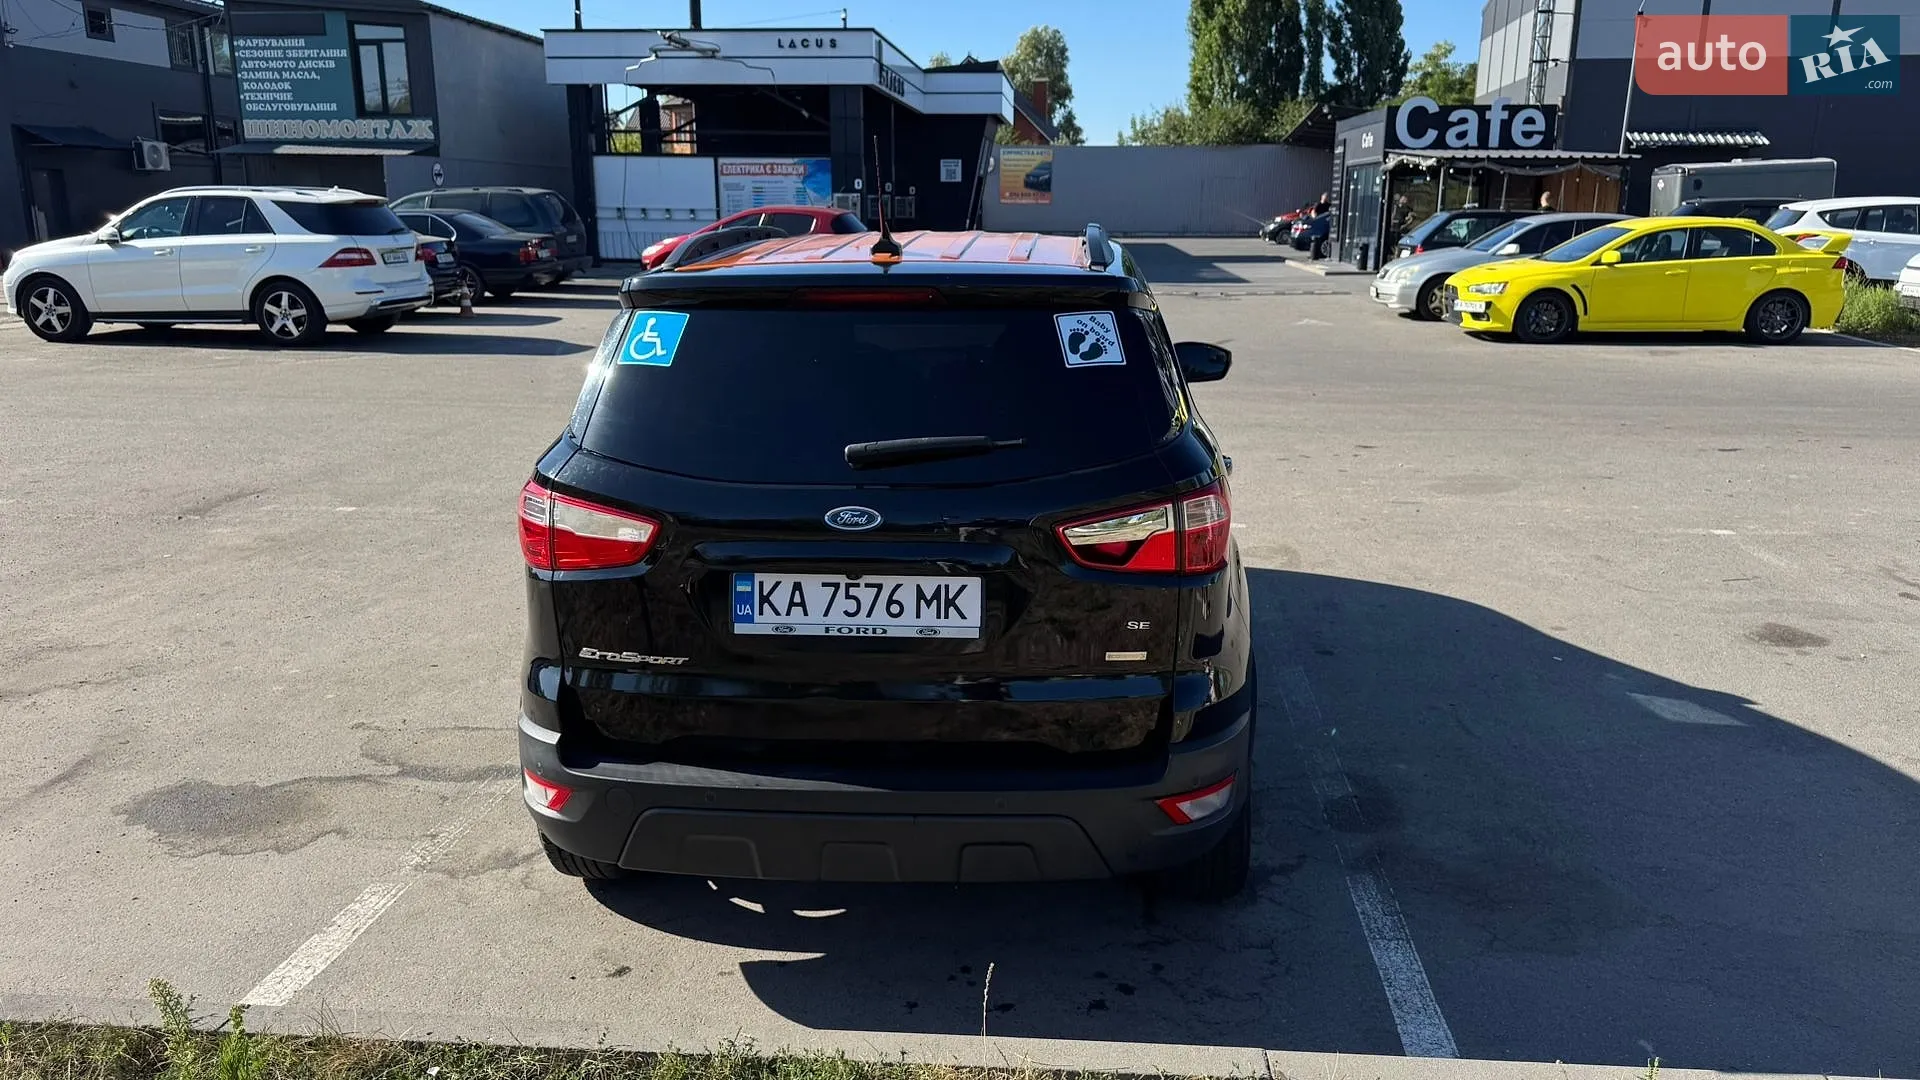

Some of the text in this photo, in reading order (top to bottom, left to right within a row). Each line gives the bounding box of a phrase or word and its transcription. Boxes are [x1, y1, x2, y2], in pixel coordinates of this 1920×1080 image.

[238, 39, 305, 47] ФАРБУВАННЯ
[777, 38, 838, 49] LACUS
[285, 49, 347, 57] ЗБЕРІГАННЯ
[241, 60, 336, 69] АВТО-МОТО ДИСКІВ
[241, 71, 321, 81] ЗАМІНА МАСЛА,
[243, 82, 292, 90] КОЛОДОК
[244, 92, 293, 100] ТЕХНІЧНЕ
[245, 103, 337, 112] ОБСЛУГОВУВАННЯ
[1395, 96, 1547, 149] Cafe
[243, 119, 435, 139] ШИНОМОНТАЖ
[1361, 131, 1374, 149] Cafe
[1089, 315, 1111, 334] Baby
[1076, 319, 1115, 347] on board
[758, 580, 969, 620] KA 7576 MK
[736, 605, 753, 616] UA
[1127, 620, 1151, 630] SE
[824, 626, 888, 635] FORD
